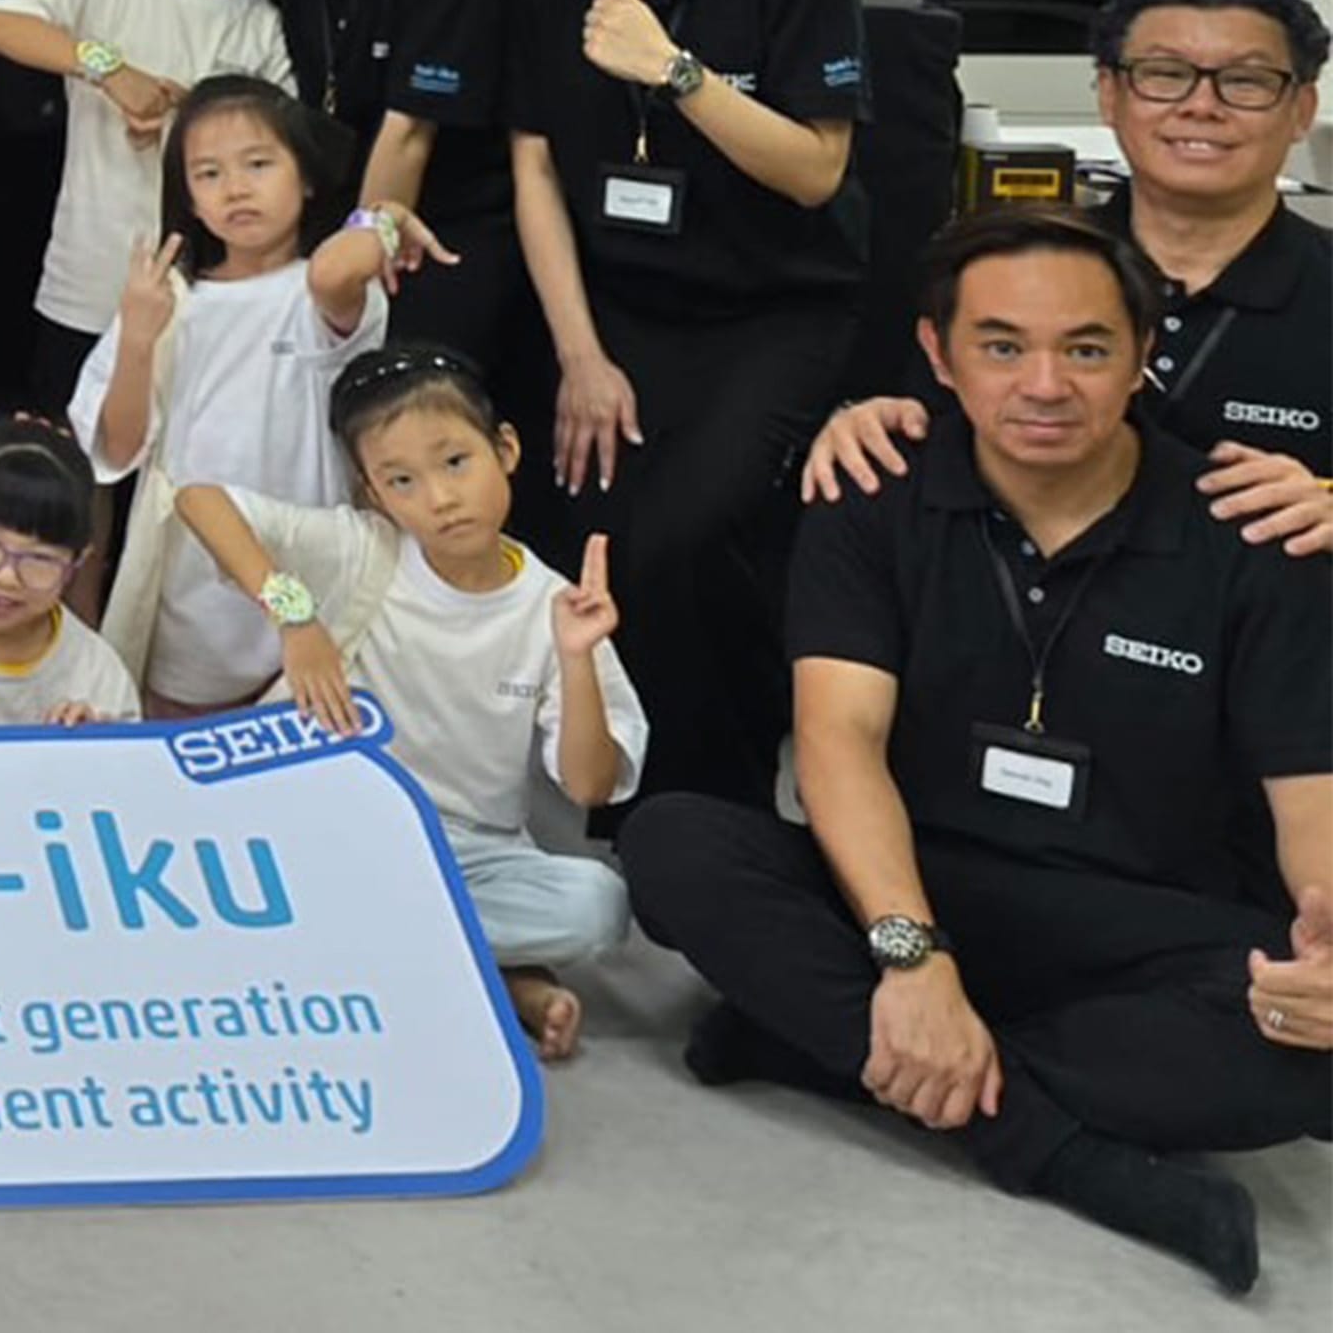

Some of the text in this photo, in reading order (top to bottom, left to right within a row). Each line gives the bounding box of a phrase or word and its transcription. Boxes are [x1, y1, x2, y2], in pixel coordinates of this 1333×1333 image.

[1223, 400, 1320, 431] SEIKO
[1103, 633, 1204, 674] SEIKO
[22, 980, 383, 1055] generation
[128, 1064, 375, 1133] activity
